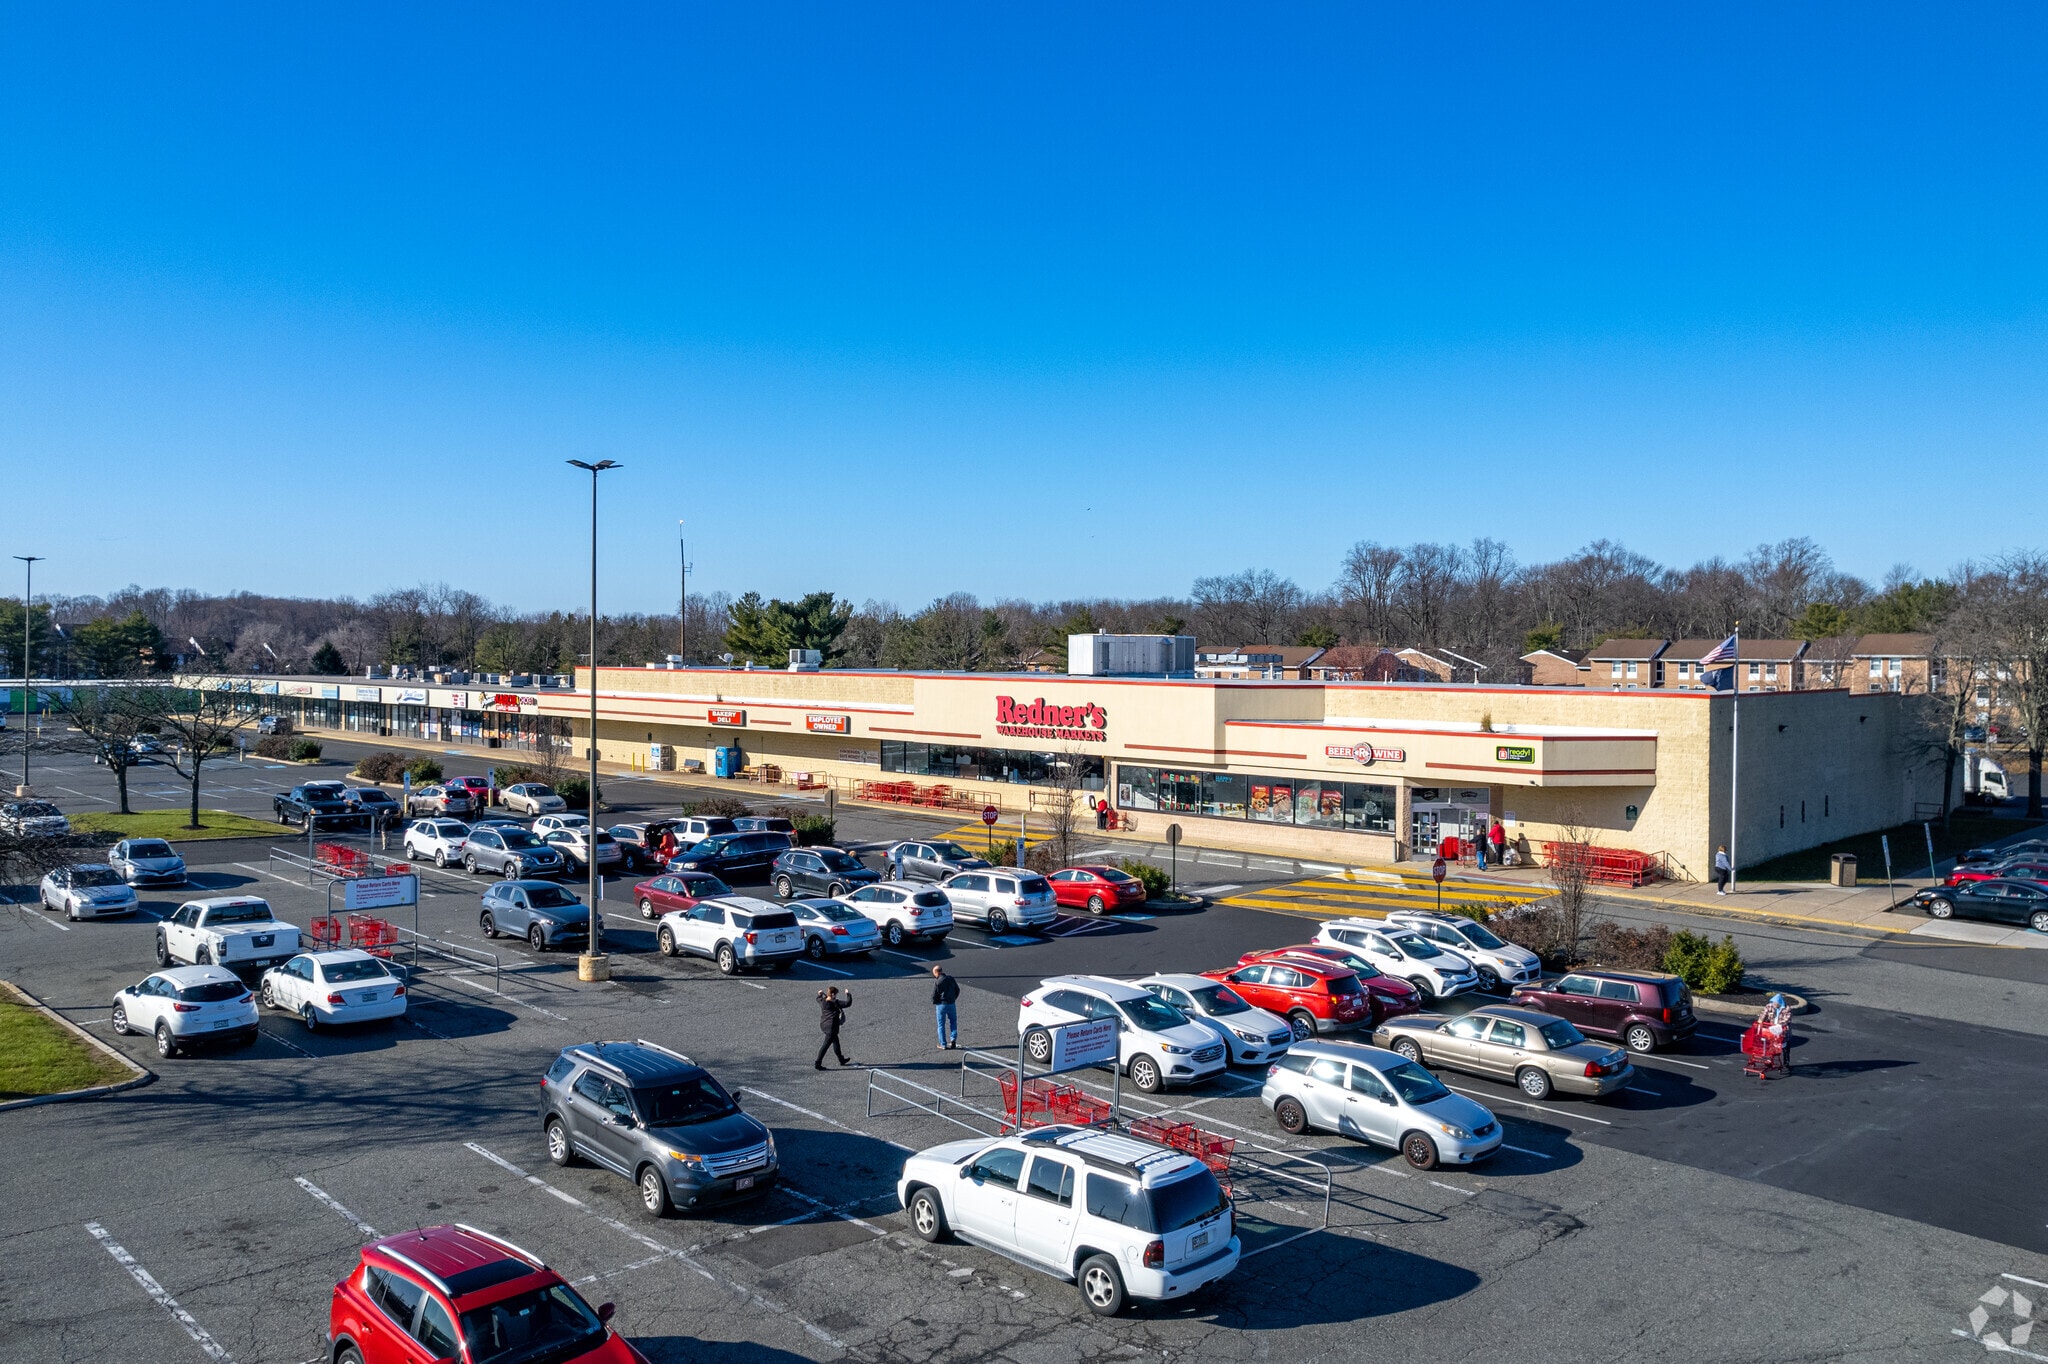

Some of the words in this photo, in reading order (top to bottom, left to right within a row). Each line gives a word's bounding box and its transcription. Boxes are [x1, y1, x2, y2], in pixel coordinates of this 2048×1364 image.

[995, 695, 1106, 729] Redner's
[808, 716, 843, 724] EMPLOYEE
[995, 725, 1055, 738] WAREHOUSE
[1055, 728, 1106, 742] MARKETS
[1328, 747, 1352, 756] BEER
[1373, 749, 1401, 759] WINE
[1161, 772, 1189, 783] MERRY
[984, 811, 998, 820] STOP
[1433, 865, 1446, 876] STOP
[1067, 1031, 1079, 1039] Please
[1080, 1029, 1092, 1037] Return
[1093, 1026, 1102, 1034] Carts
